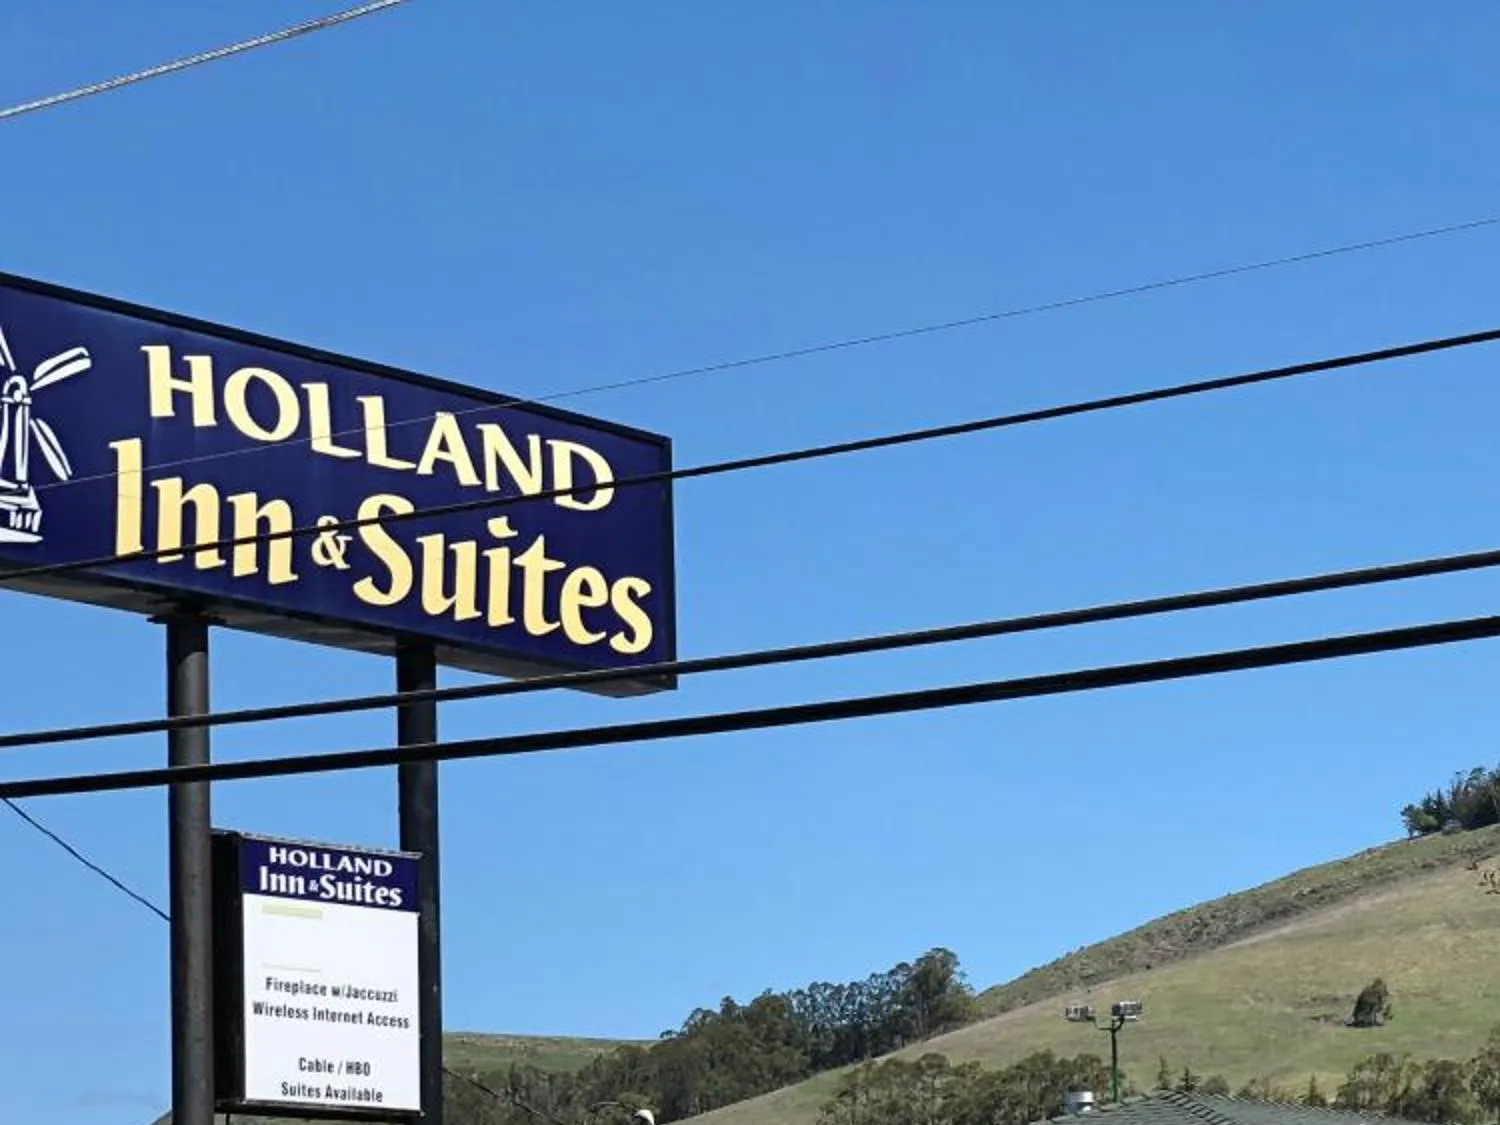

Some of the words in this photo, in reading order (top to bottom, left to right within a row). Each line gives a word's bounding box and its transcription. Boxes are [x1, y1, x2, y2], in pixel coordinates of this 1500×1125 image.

[142, 345, 615, 511] HOLLAND
[109, 438, 298, 584] Inn
[311, 514, 352, 570] &
[352, 494, 653, 655] Suites
[268, 847, 393, 877] HOLLAND
[258, 865, 306, 896] Inn
[319, 874, 403, 907] Suites
[265, 977, 327, 997] Fireplace
[252, 1001, 309, 1020] Wireless
[313, 1006, 363, 1024] Internet
[367, 1012, 409, 1029] Access
[298, 1057, 335, 1073] Cable
[346, 1061, 371, 1076] HBO
[281, 1082, 321, 1098] Suites
[325, 1084, 383, 1102] Available
